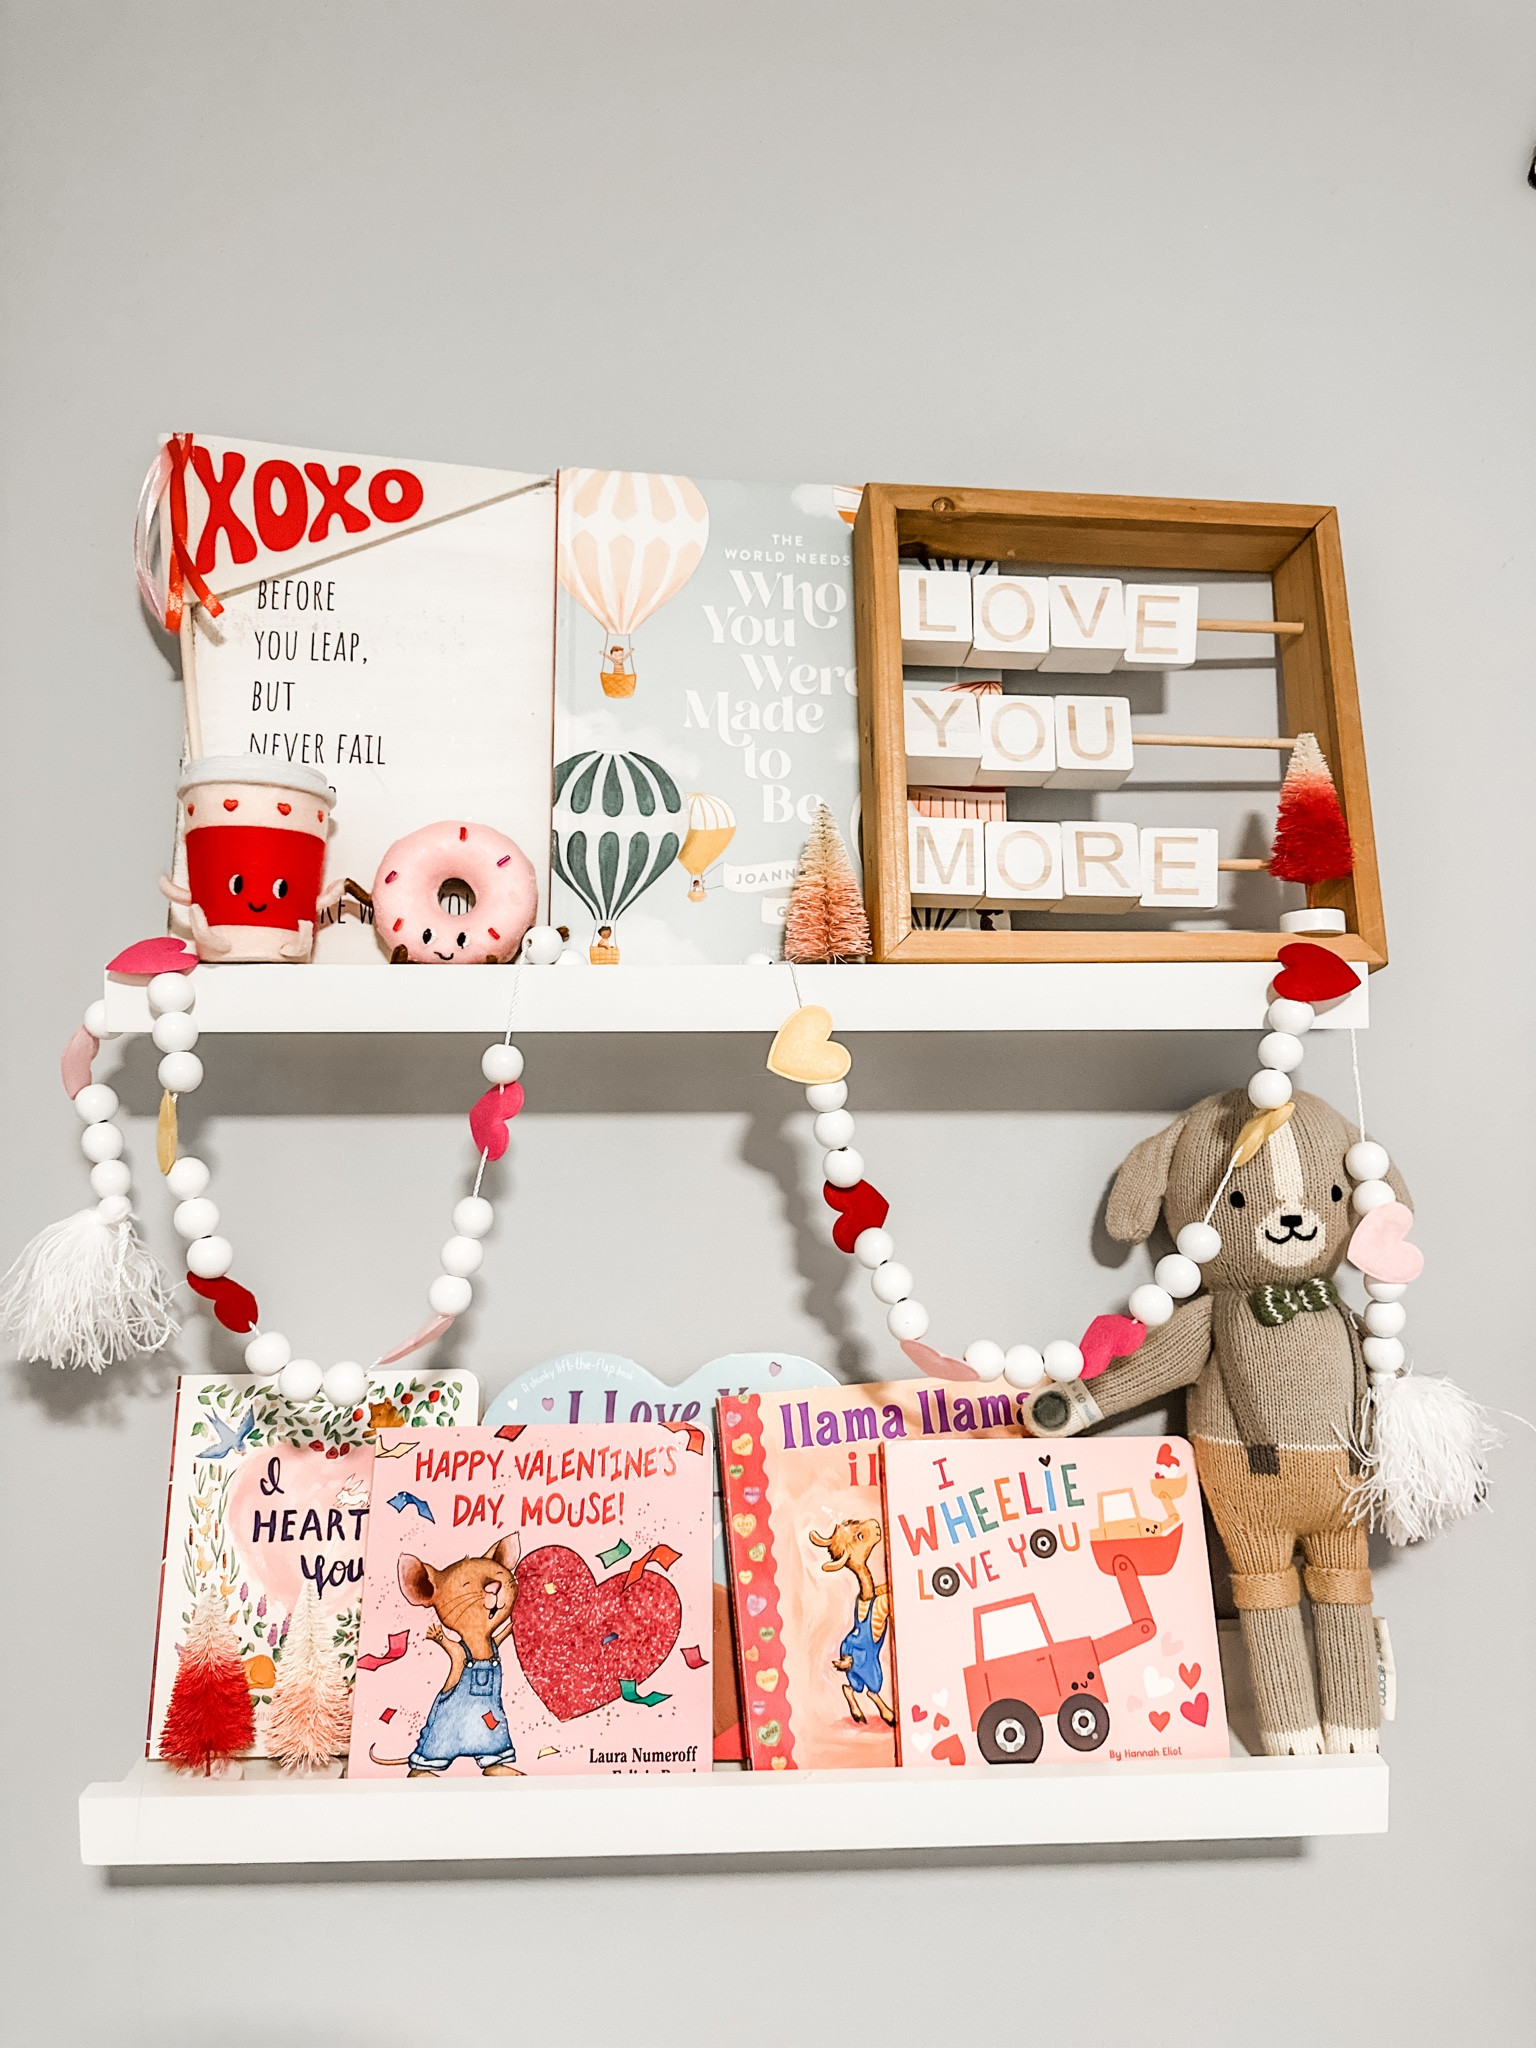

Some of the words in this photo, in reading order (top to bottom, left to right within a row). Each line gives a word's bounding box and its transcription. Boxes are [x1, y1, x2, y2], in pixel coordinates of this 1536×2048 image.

[191, 445, 424, 576] XOXO
[724, 548, 786, 564] WORLD
[795, 553, 851, 567] NEEDS
[771, 533, 804, 547] THE
[257, 579, 336, 612] BEFORE
[728, 568, 848, 630] Who
[701, 604, 796, 648] You
[917, 577, 1181, 656] LOVE
[254, 630, 298, 661] YOU
[310, 631, 368, 665] LEAP,
[251, 680, 296, 712] BUT
[682, 689, 826, 748] Made
[910, 697, 1117, 762] YOU
[249, 732, 325, 764] NEVER
[336, 733, 386, 765] FAIL
[743, 740, 792, 780] to
[735, 868, 796, 885] JOANN
[915, 825, 1200, 896] MORE
[779, 1400, 908, 1450] llama
[260, 1456, 285, 1496] I
[415, 1448, 504, 1482] HAPPY
[514, 1445, 679, 1486] VALENTINE'S
[932, 1457, 955, 1491] I
[252, 1508, 370, 1543] HEART
[453, 1493, 505, 1529] DAY,
[520, 1491, 625, 1528] MOUSE!
[917, 1549, 1001, 1601] LOVE
[1007, 1521, 1081, 1569] YOU
[762, 1726, 780, 1741] LOVE
[589, 1748, 628, 1764] Laura
[631, 1745, 698, 1763] Numeroff
[1109, 1749, 1122, 1762] By
[1124, 1747, 1160, 1759] Hannah
[1162, 1745, 1182, 1757] Eliot
